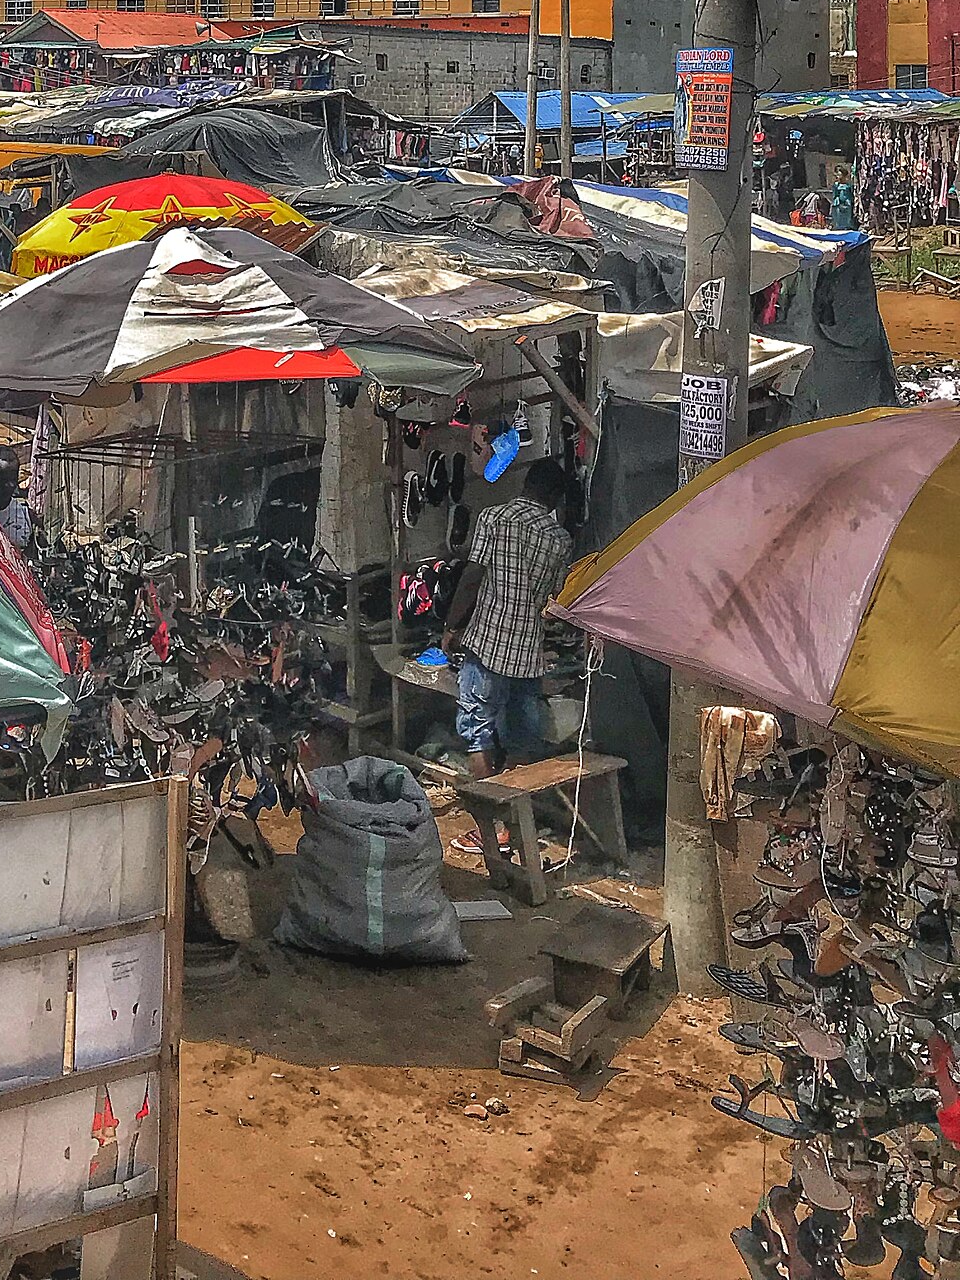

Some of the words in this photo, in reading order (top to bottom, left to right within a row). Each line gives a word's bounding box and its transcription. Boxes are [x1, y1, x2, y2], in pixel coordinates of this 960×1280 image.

[704, 49, 730, 61] LORD
[702, 61, 730, 71] TEMPLE
[709, 137, 726, 146] RINGS
[683, 378, 721, 390] JOB
[692, 389, 724, 404] FACTORY
